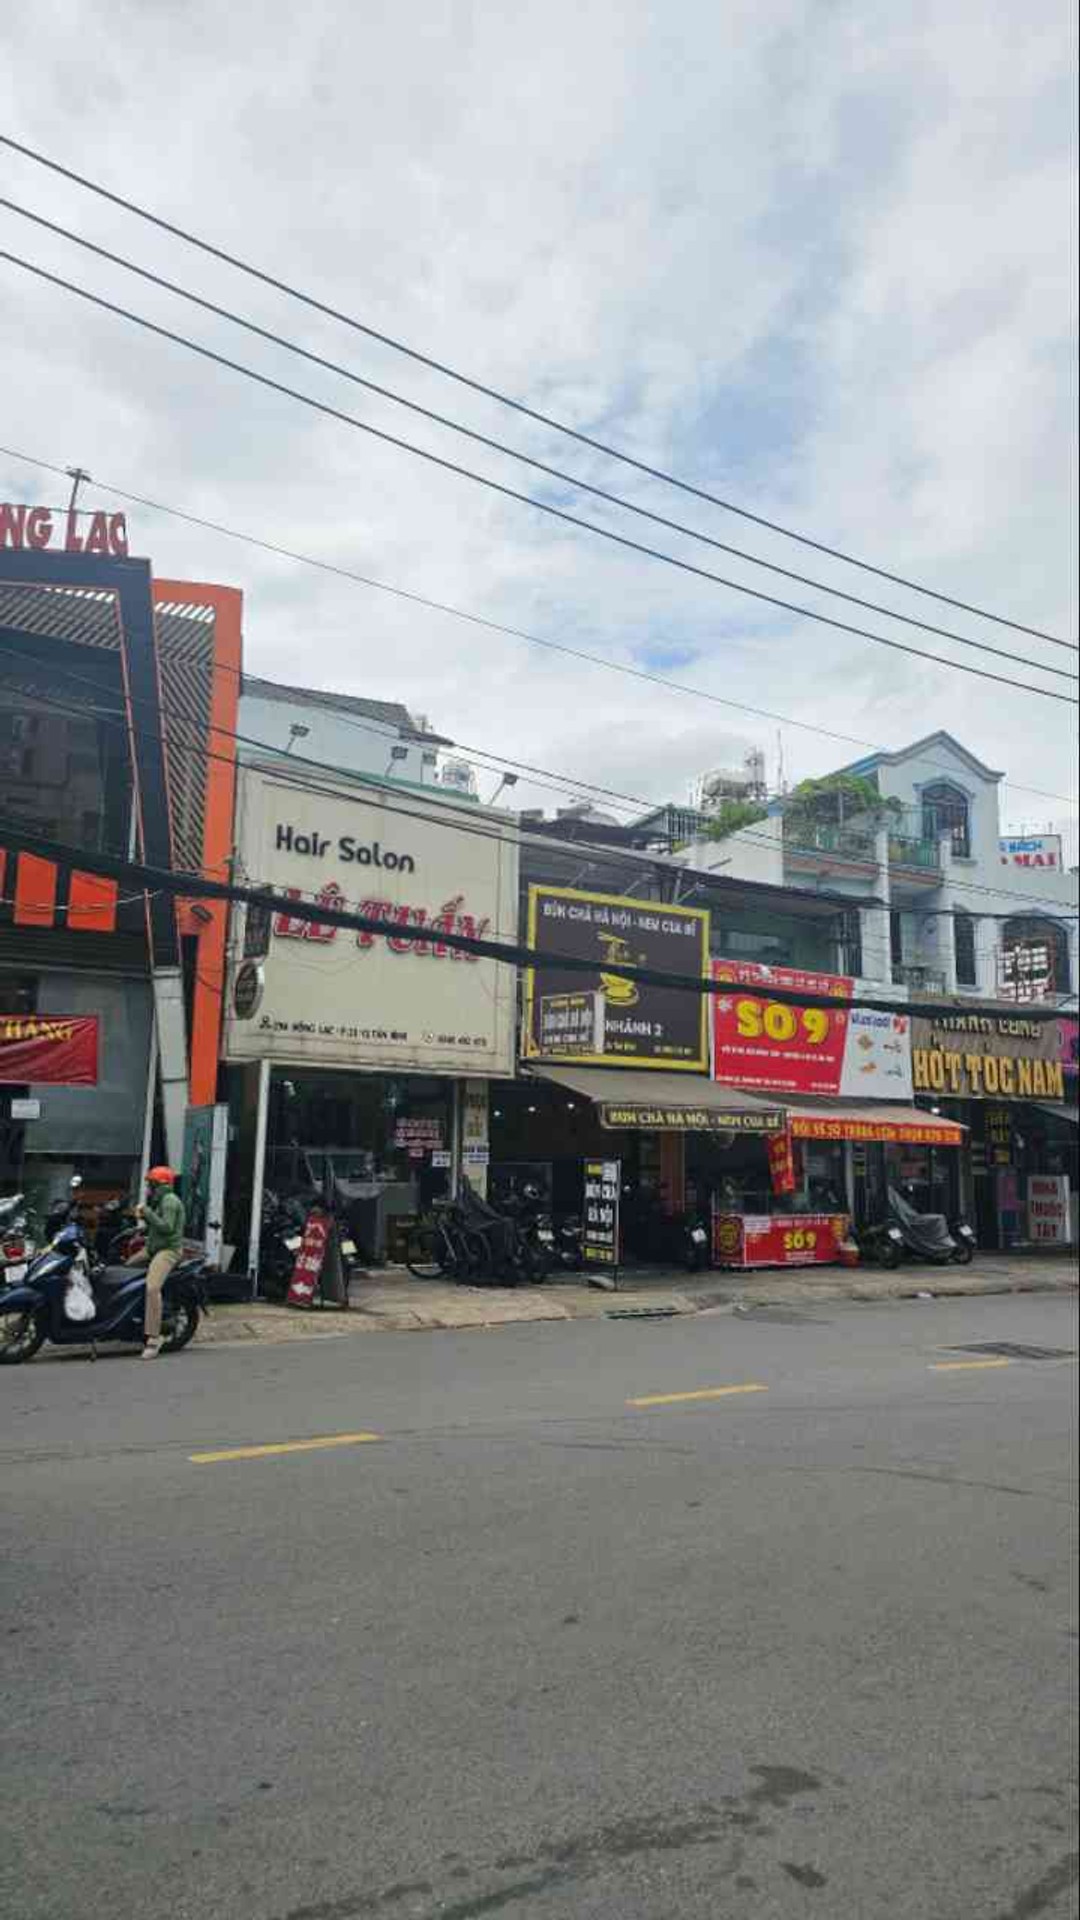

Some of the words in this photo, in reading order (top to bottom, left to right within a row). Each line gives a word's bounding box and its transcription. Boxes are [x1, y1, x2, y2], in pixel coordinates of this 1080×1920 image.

[276, 823, 331, 858] Hair
[338, 836, 415, 873] Salon
[803, 1005, 829, 1046] 9
[1017, 1057, 1064, 1097] NAM
[806, 1232, 817, 1249] 9
